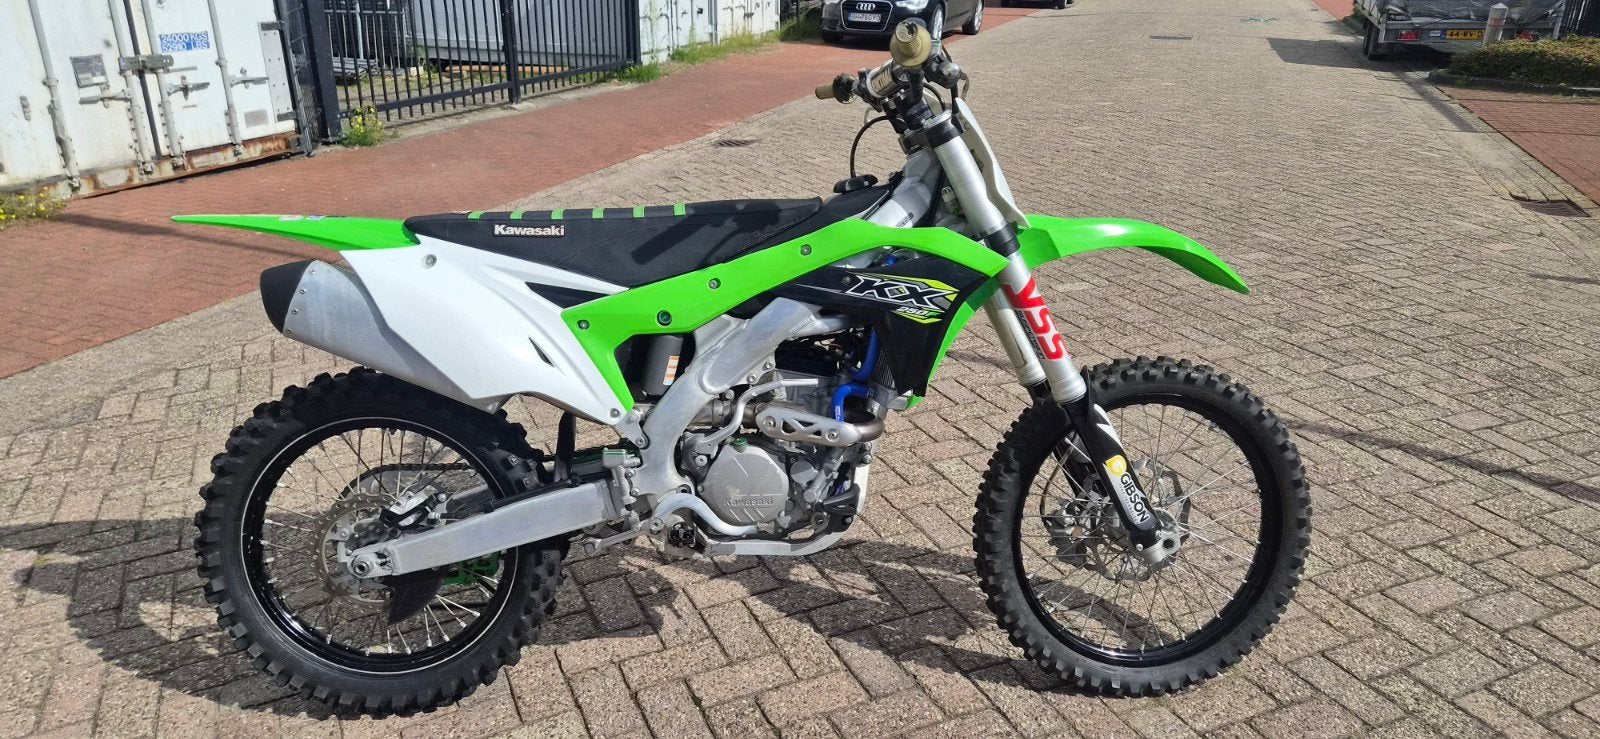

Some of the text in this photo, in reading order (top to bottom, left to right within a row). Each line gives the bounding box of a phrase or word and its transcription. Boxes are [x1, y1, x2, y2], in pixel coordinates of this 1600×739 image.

[161, 31, 208, 42] 24000 KGS
[191, 40, 208, 50] LBS
[494, 224, 565, 236] Kawasaki
[845, 275, 954, 310] KX
[723, 495, 774, 507] Kawasaki
[1121, 473, 1150, 523] GIBSON
